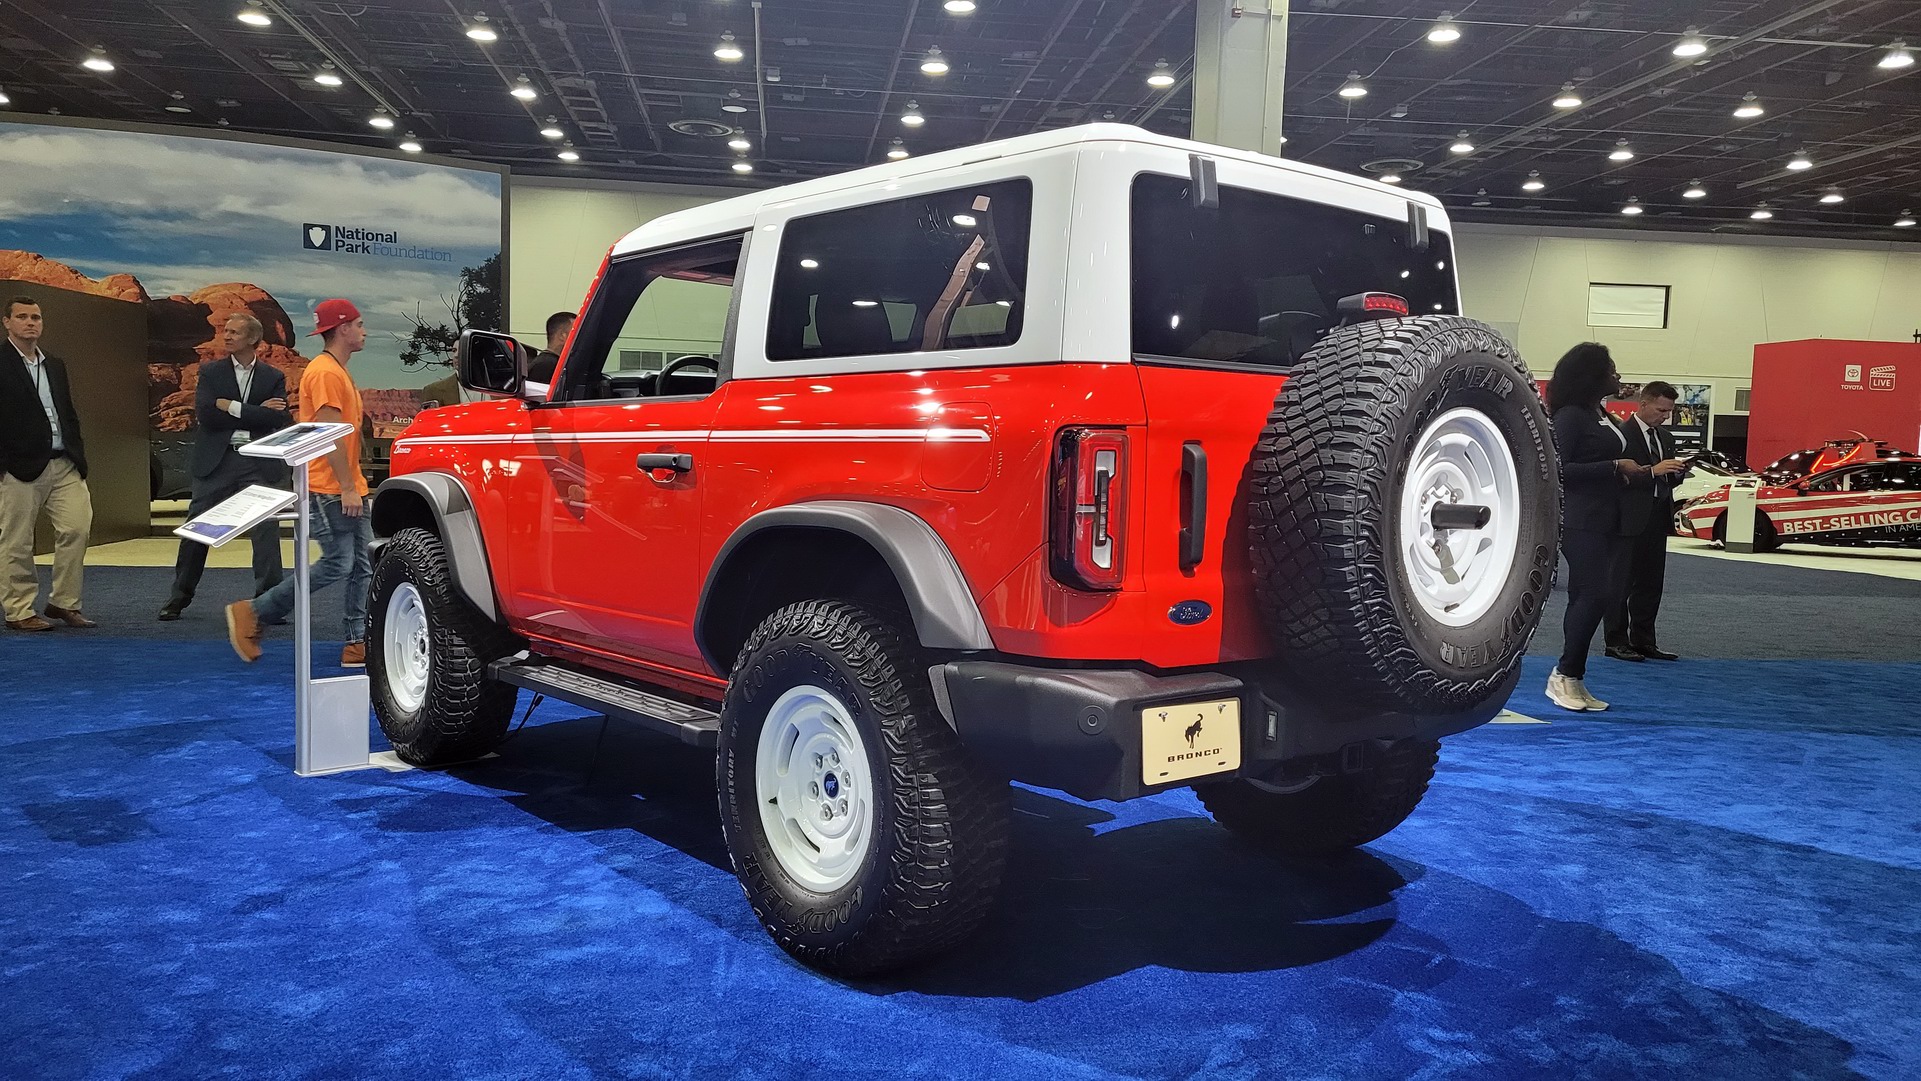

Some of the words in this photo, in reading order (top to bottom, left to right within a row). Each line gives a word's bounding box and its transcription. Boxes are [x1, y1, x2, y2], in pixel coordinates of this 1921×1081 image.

[335, 225, 397, 244] National
[335, 239, 371, 255] Park
[372, 242, 453, 262] Foundation
[1872, 378, 1892, 387] LIVE
[1519, 404, 1550, 481] TERRITORY
[1782, 511, 1903, 534] BEST-SELLING
[1906, 509, 1921, 524] C
[1885, 525, 1897, 533] IN
[1167, 748, 1220, 763] BRONCO
